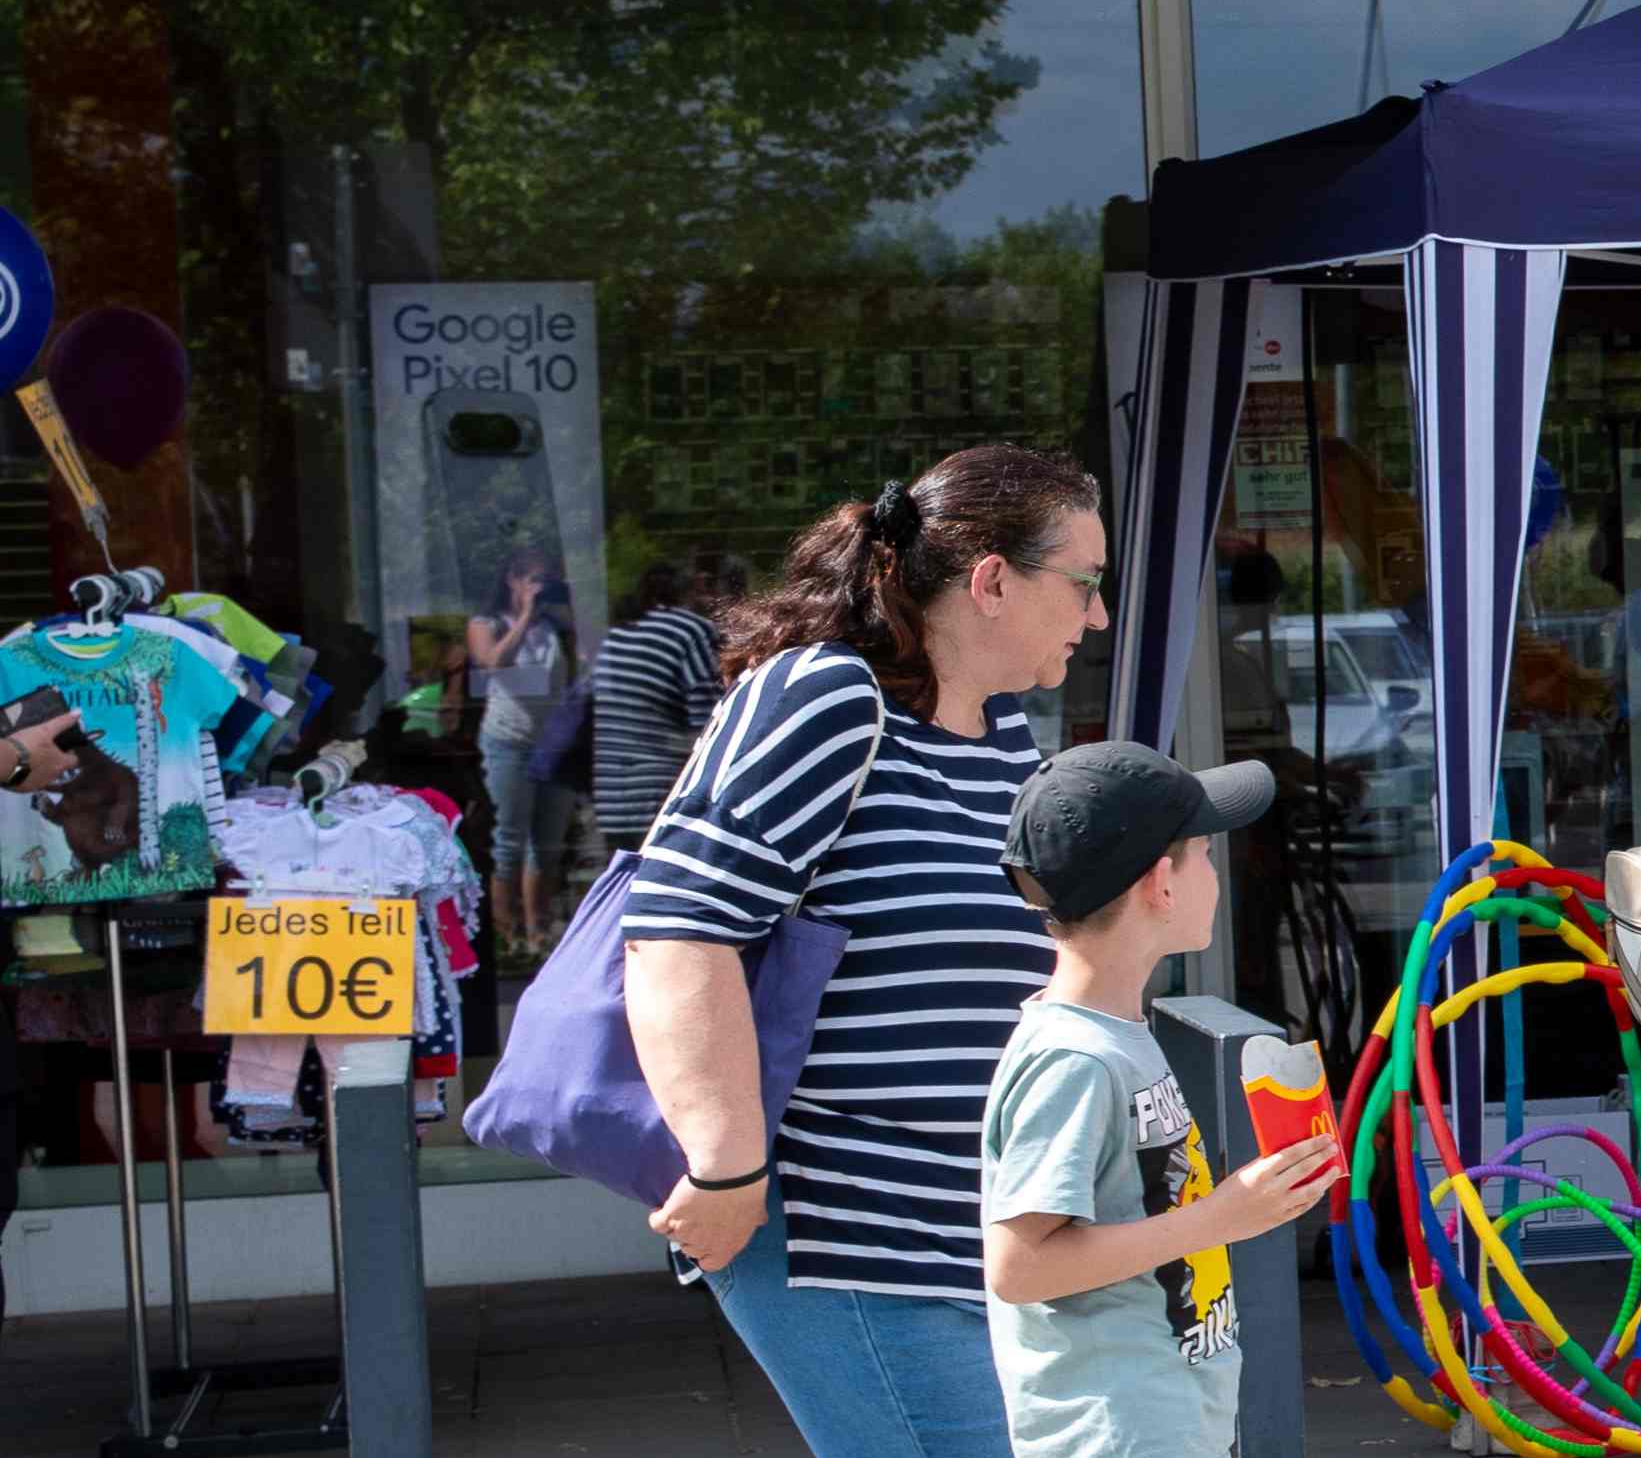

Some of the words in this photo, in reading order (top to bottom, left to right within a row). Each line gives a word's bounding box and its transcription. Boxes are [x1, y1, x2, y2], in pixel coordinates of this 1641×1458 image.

[393, 303, 578, 355] Google
[404, 355, 512, 393] Pixel
[525, 353, 577, 392] 10
[218, 905, 330, 937] Jedes
[340, 905, 407, 937] Teil
[236, 956, 394, 1021] 10€
